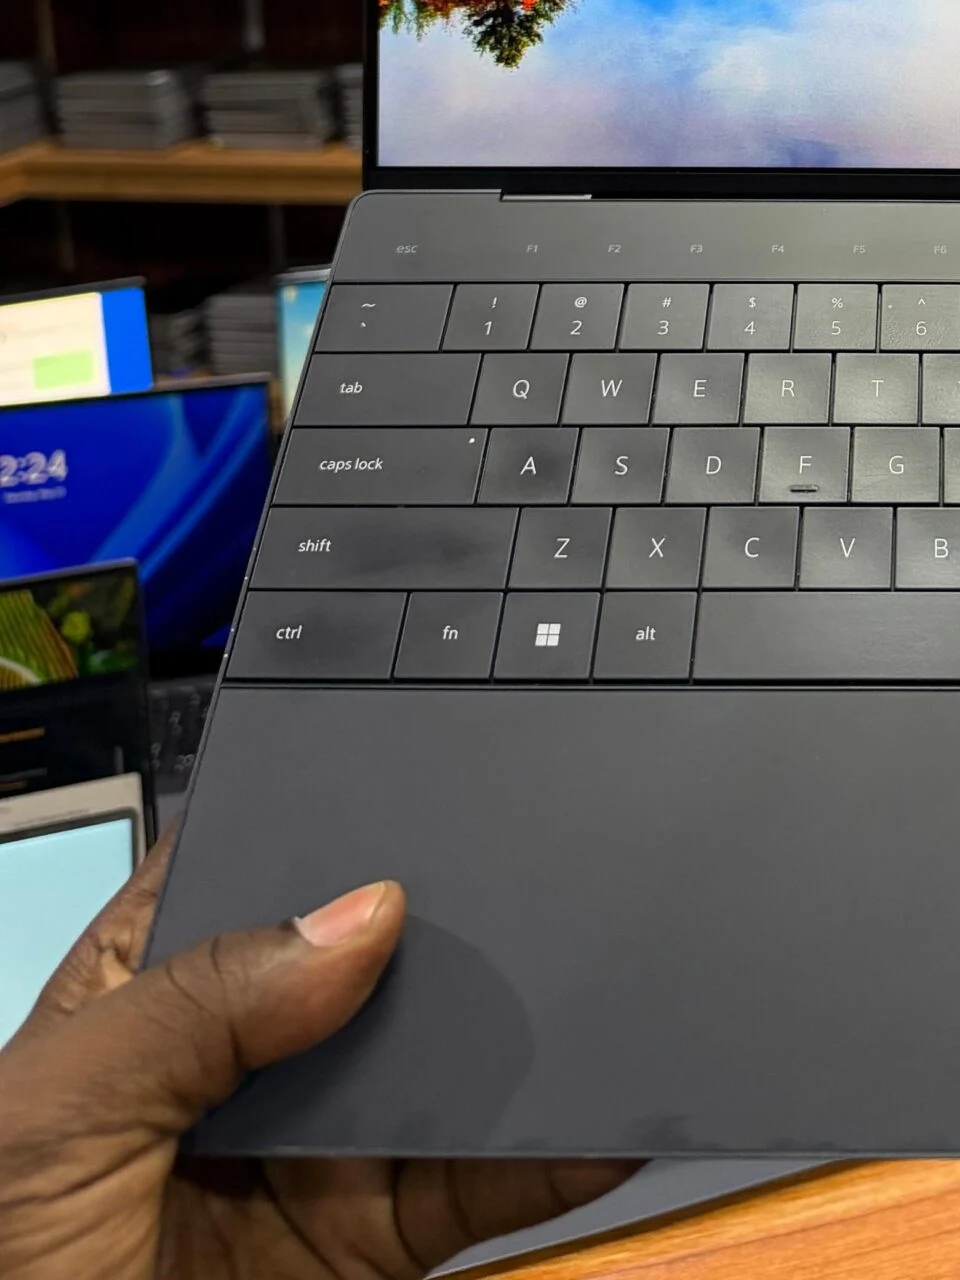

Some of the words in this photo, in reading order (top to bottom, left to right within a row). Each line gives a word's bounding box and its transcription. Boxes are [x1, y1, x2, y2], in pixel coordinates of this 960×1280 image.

[396, 244, 418, 254] esc
[526, 244, 539, 253] F1
[607, 244, 622, 253] F2
[690, 244, 704, 254] F3
[771, 244, 785, 253] F4
[852, 244, 866, 254] F5
[933, 245, 948, 254] F6
[574, 296, 588, 309] @
[748, 296, 757, 309] $
[831, 297, 844, 309] %
[484, 321, 492, 336] 1
[570, 319, 583, 335] 2
[657, 320, 669, 335] 3
[744, 320, 756, 335] 4
[831, 320, 841, 336] 5
[915, 320, 927, 336] 6
[340, 381, 363, 394] tab
[512, 379, 530, 400] Q
[601, 379, 623, 397] W
[693, 379, 707, 398] E
[781, 379, 795, 397] R
[871, 379, 885, 398] T
[319, 460, 353, 474] caps
[354, 457, 383, 471] lock
[520, 456, 537, 475] A
[614, 455, 629, 476] S
[705, 455, 722, 475] D
[799, 455, 813, 475] F
[888, 455, 905, 475] G
[297, 538, 332, 553] shift
[553, 537, 571, 559] Z
[648, 537, 666, 558] X
[744, 537, 760, 558] C
[839, 537, 856, 558] V
[934, 538, 949, 559] B
[275, 624, 303, 640] ctrl
[442, 625, 459, 640] fn
[635, 625, 656, 641] alt
